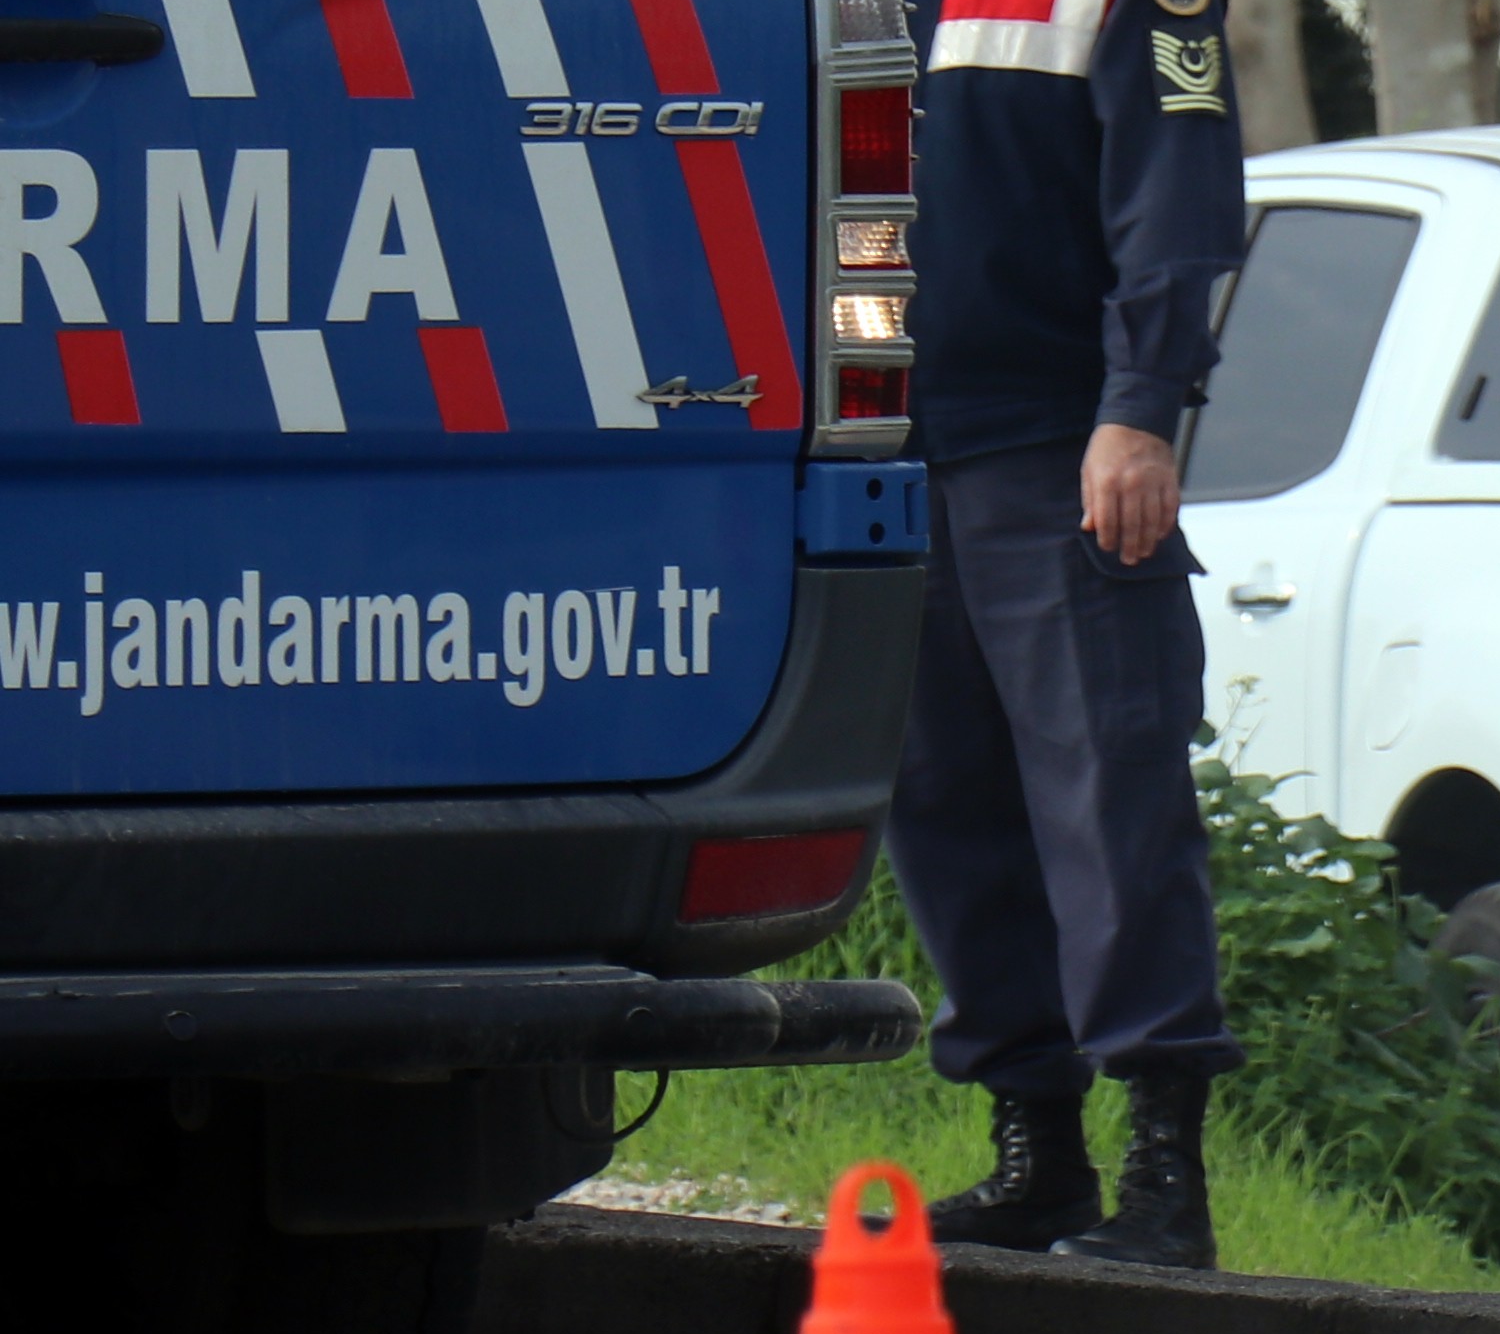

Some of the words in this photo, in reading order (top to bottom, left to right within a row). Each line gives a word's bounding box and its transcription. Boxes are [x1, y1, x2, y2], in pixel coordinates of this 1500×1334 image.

[520, 101, 643, 136] 316
[656, 101, 764, 136] CDI
[0, 148, 460, 323] RMA
[636, 374, 764, 409] 4x4
[0, 565, 720, 717] w.jandarma.gov.tr
